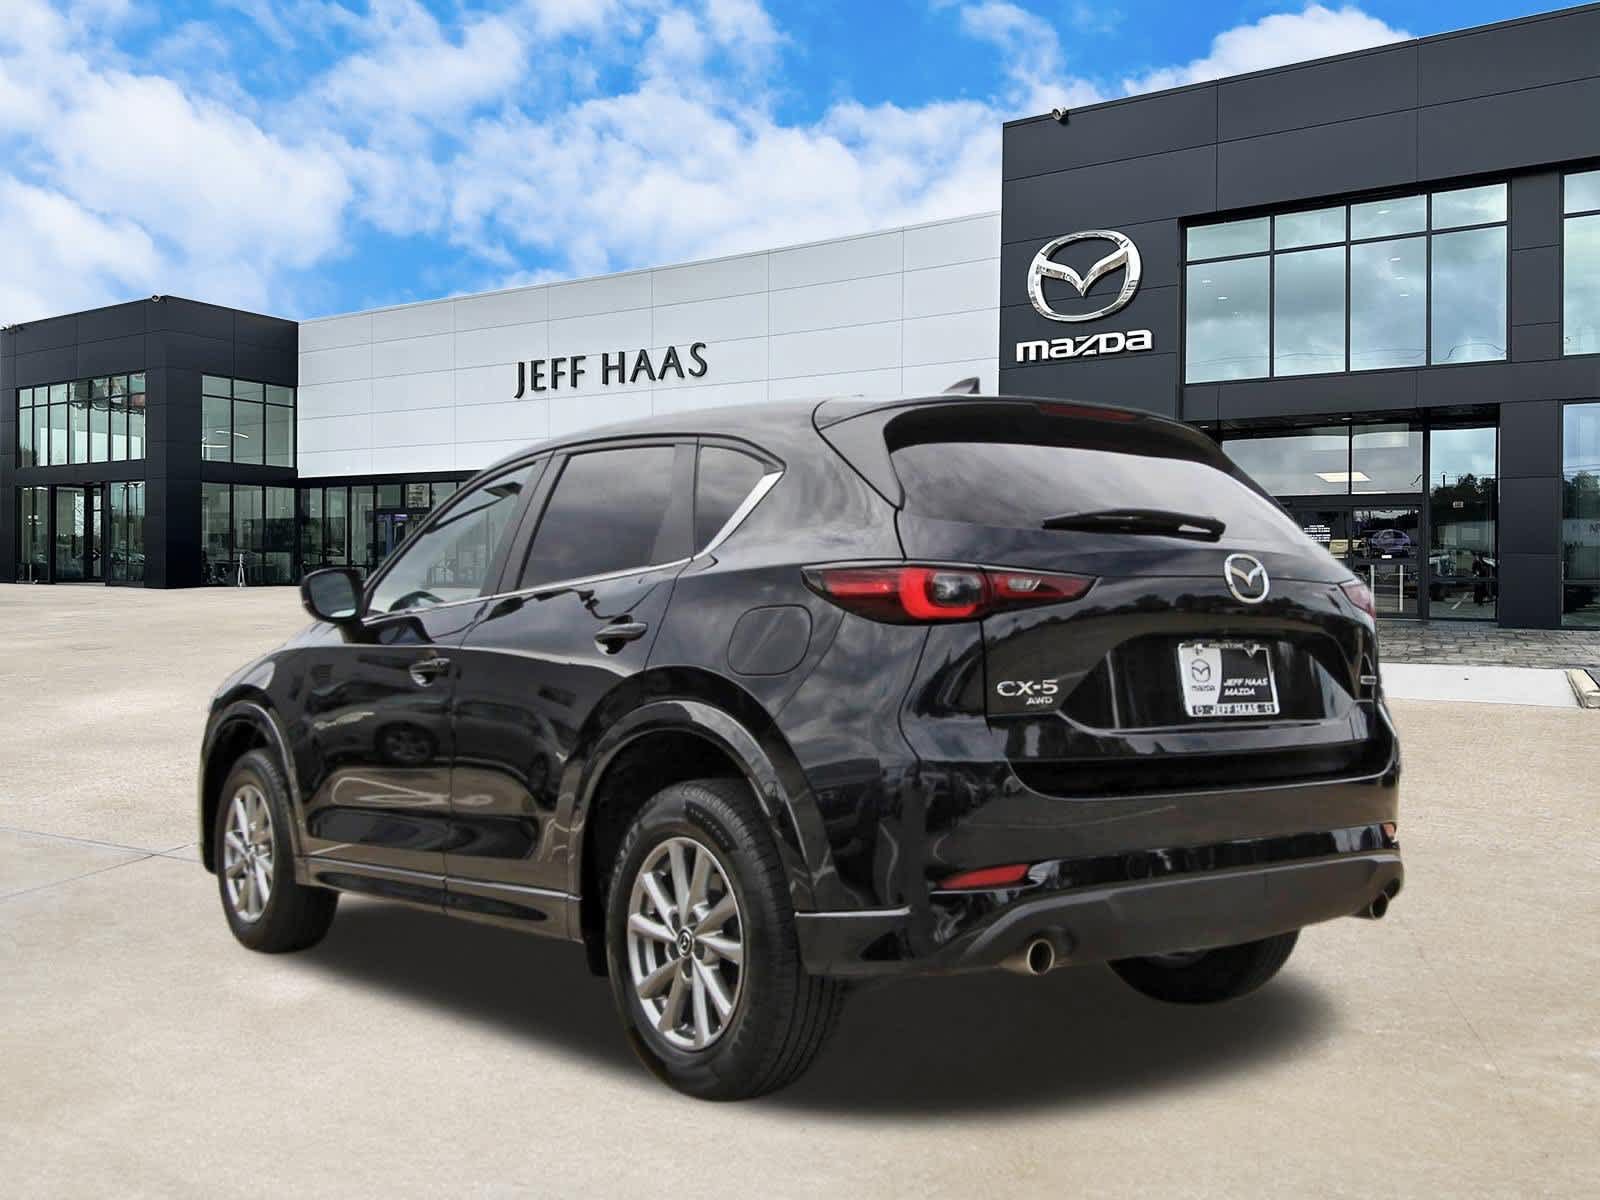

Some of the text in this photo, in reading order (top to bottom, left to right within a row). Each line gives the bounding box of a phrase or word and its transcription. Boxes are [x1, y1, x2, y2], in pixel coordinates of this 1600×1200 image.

[514, 342, 708, 399] JEFF HAAS
[1223, 678, 1268, 687] JEFF HAAS
[996, 679, 1059, 697] CX-5
[1224, 687, 1256, 696] MAZDA
[1026, 696, 1053, 705] AWD
[1235, 703, 1258, 713] HAAS
